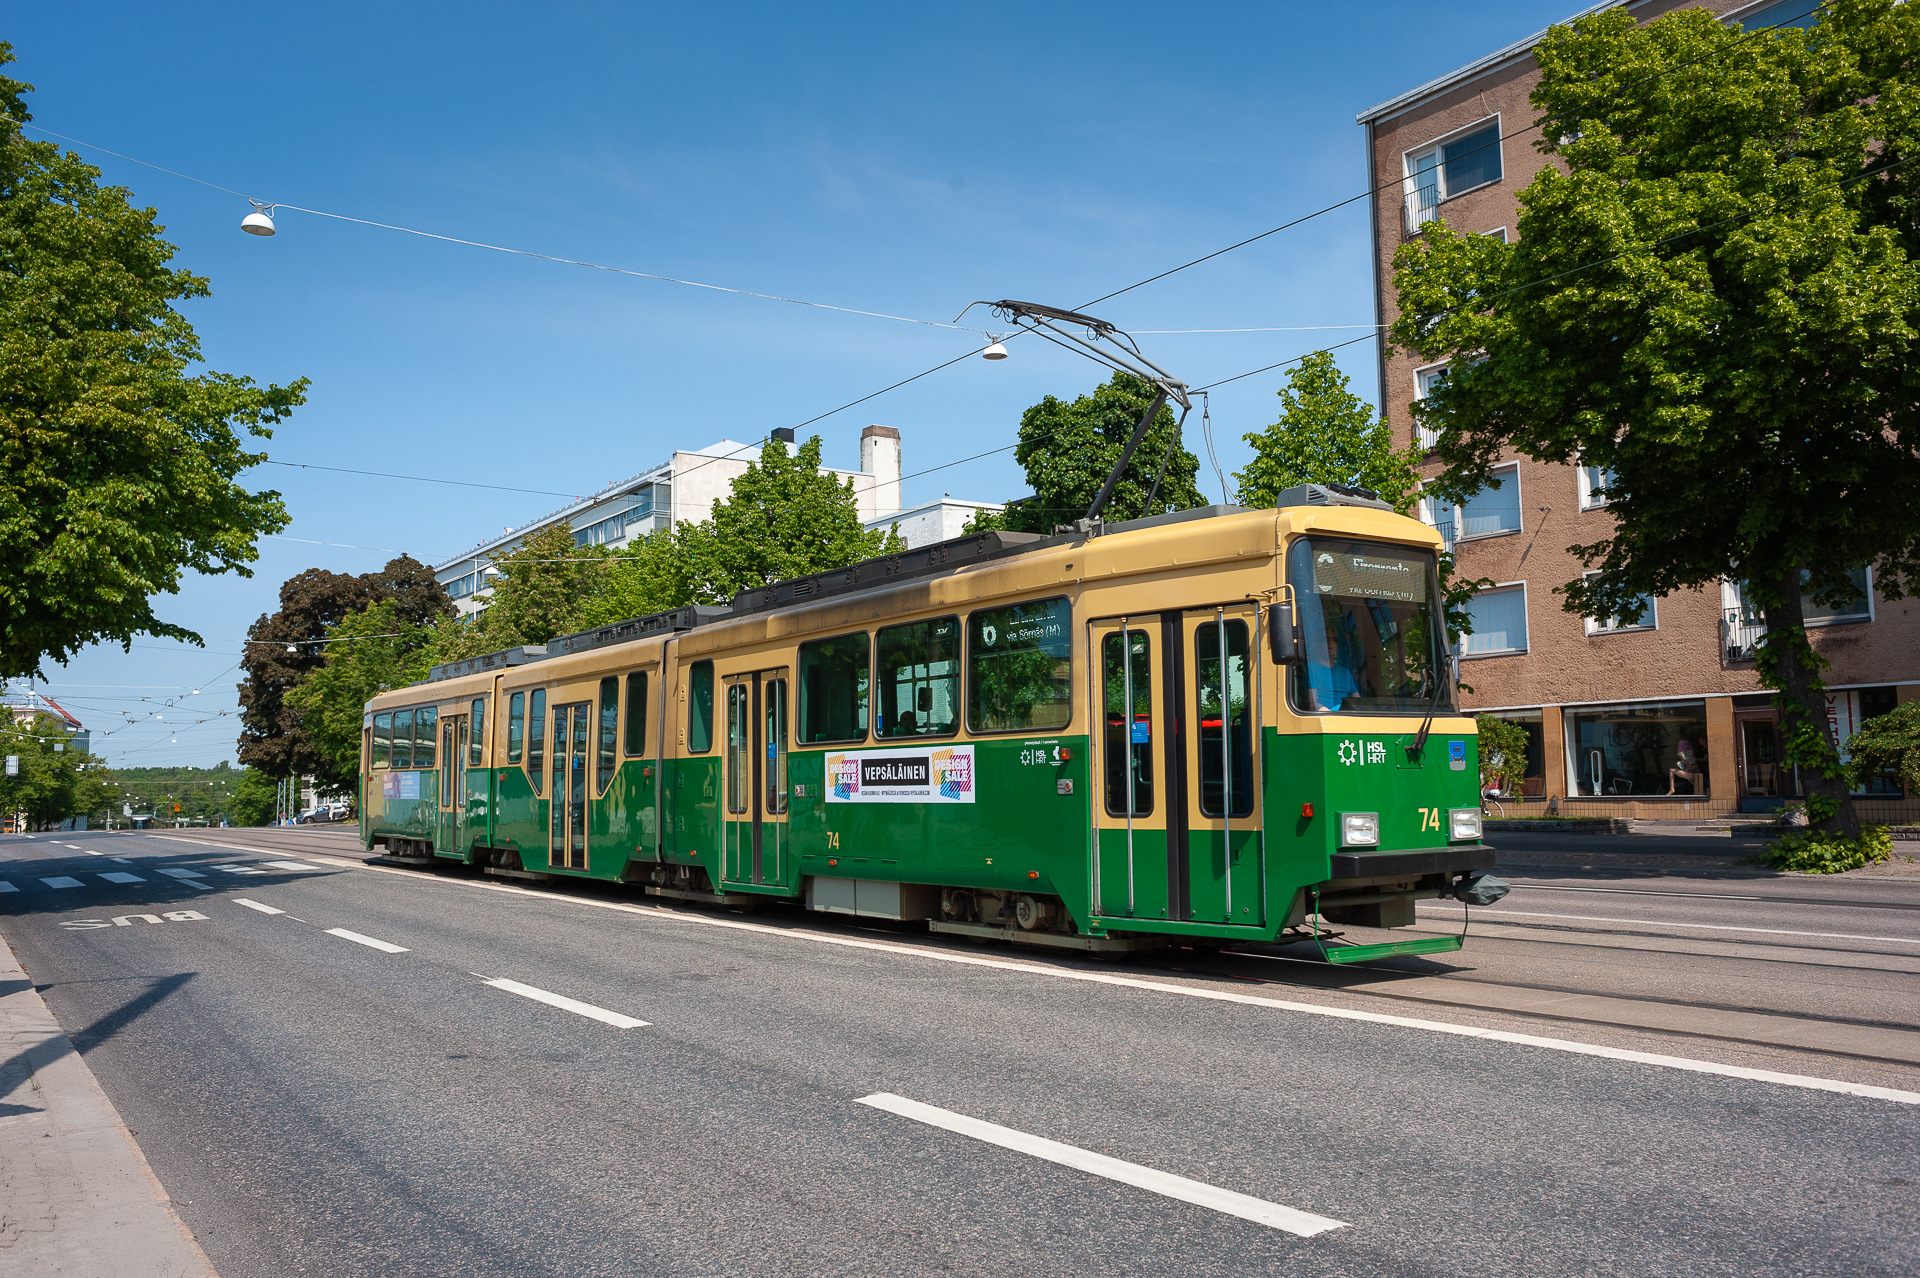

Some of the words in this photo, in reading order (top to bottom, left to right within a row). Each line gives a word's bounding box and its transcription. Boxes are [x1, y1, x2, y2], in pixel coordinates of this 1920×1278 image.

[1367, 742, 1386, 752] HSL
[1367, 753, 1386, 763] HRT
[830, 763, 857, 773] DESIGN
[934, 759, 968, 771] DESIGN
[864, 763, 926, 780] VEPSÄLÄINEN
[945, 770, 968, 782] SALE
[838, 774, 857, 784] SALE
[1418, 807, 1440, 832] 74
[826, 831, 839, 849] 74
[58, 910, 211, 930] BUS
